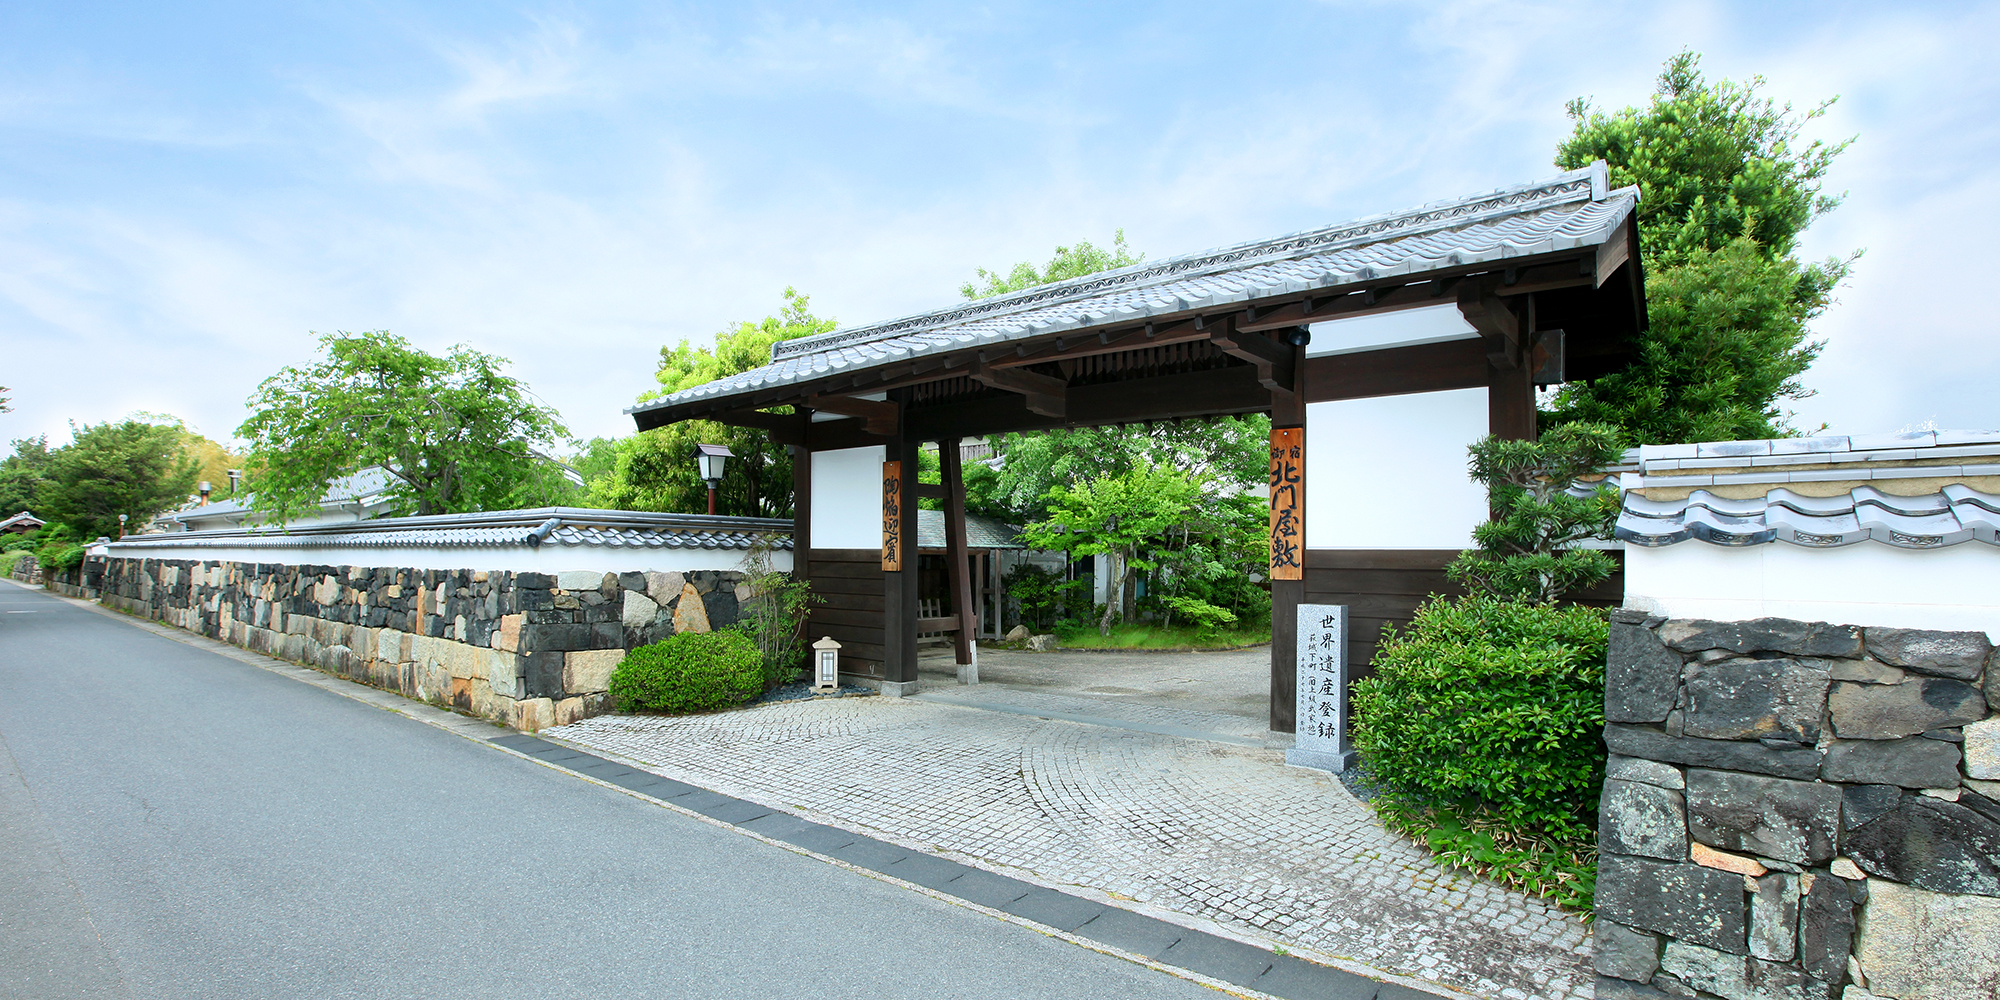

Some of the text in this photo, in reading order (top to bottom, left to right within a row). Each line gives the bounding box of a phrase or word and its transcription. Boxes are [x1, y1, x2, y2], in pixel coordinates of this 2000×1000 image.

[1271, 461, 1300, 569] 北門屋敷
[1318, 615, 1336, 739] 世界遺産登録
